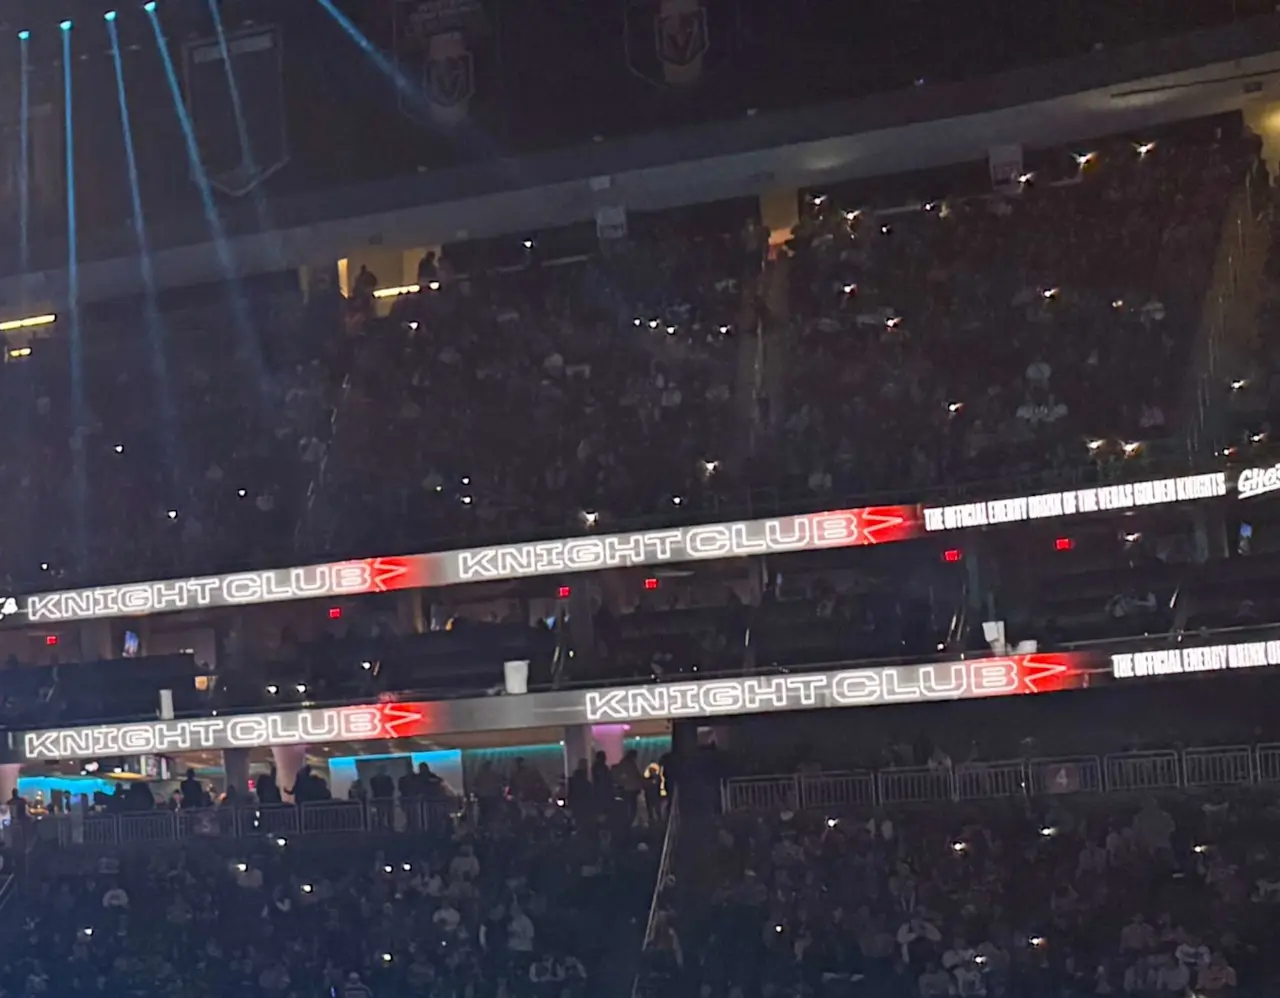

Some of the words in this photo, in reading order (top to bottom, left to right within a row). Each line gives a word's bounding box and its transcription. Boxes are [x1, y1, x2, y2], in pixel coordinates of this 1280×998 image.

[924, 507, 944, 530] THE
[1176, 472, 1226, 500] KNIGHTS
[1112, 653, 1134, 677] THE
